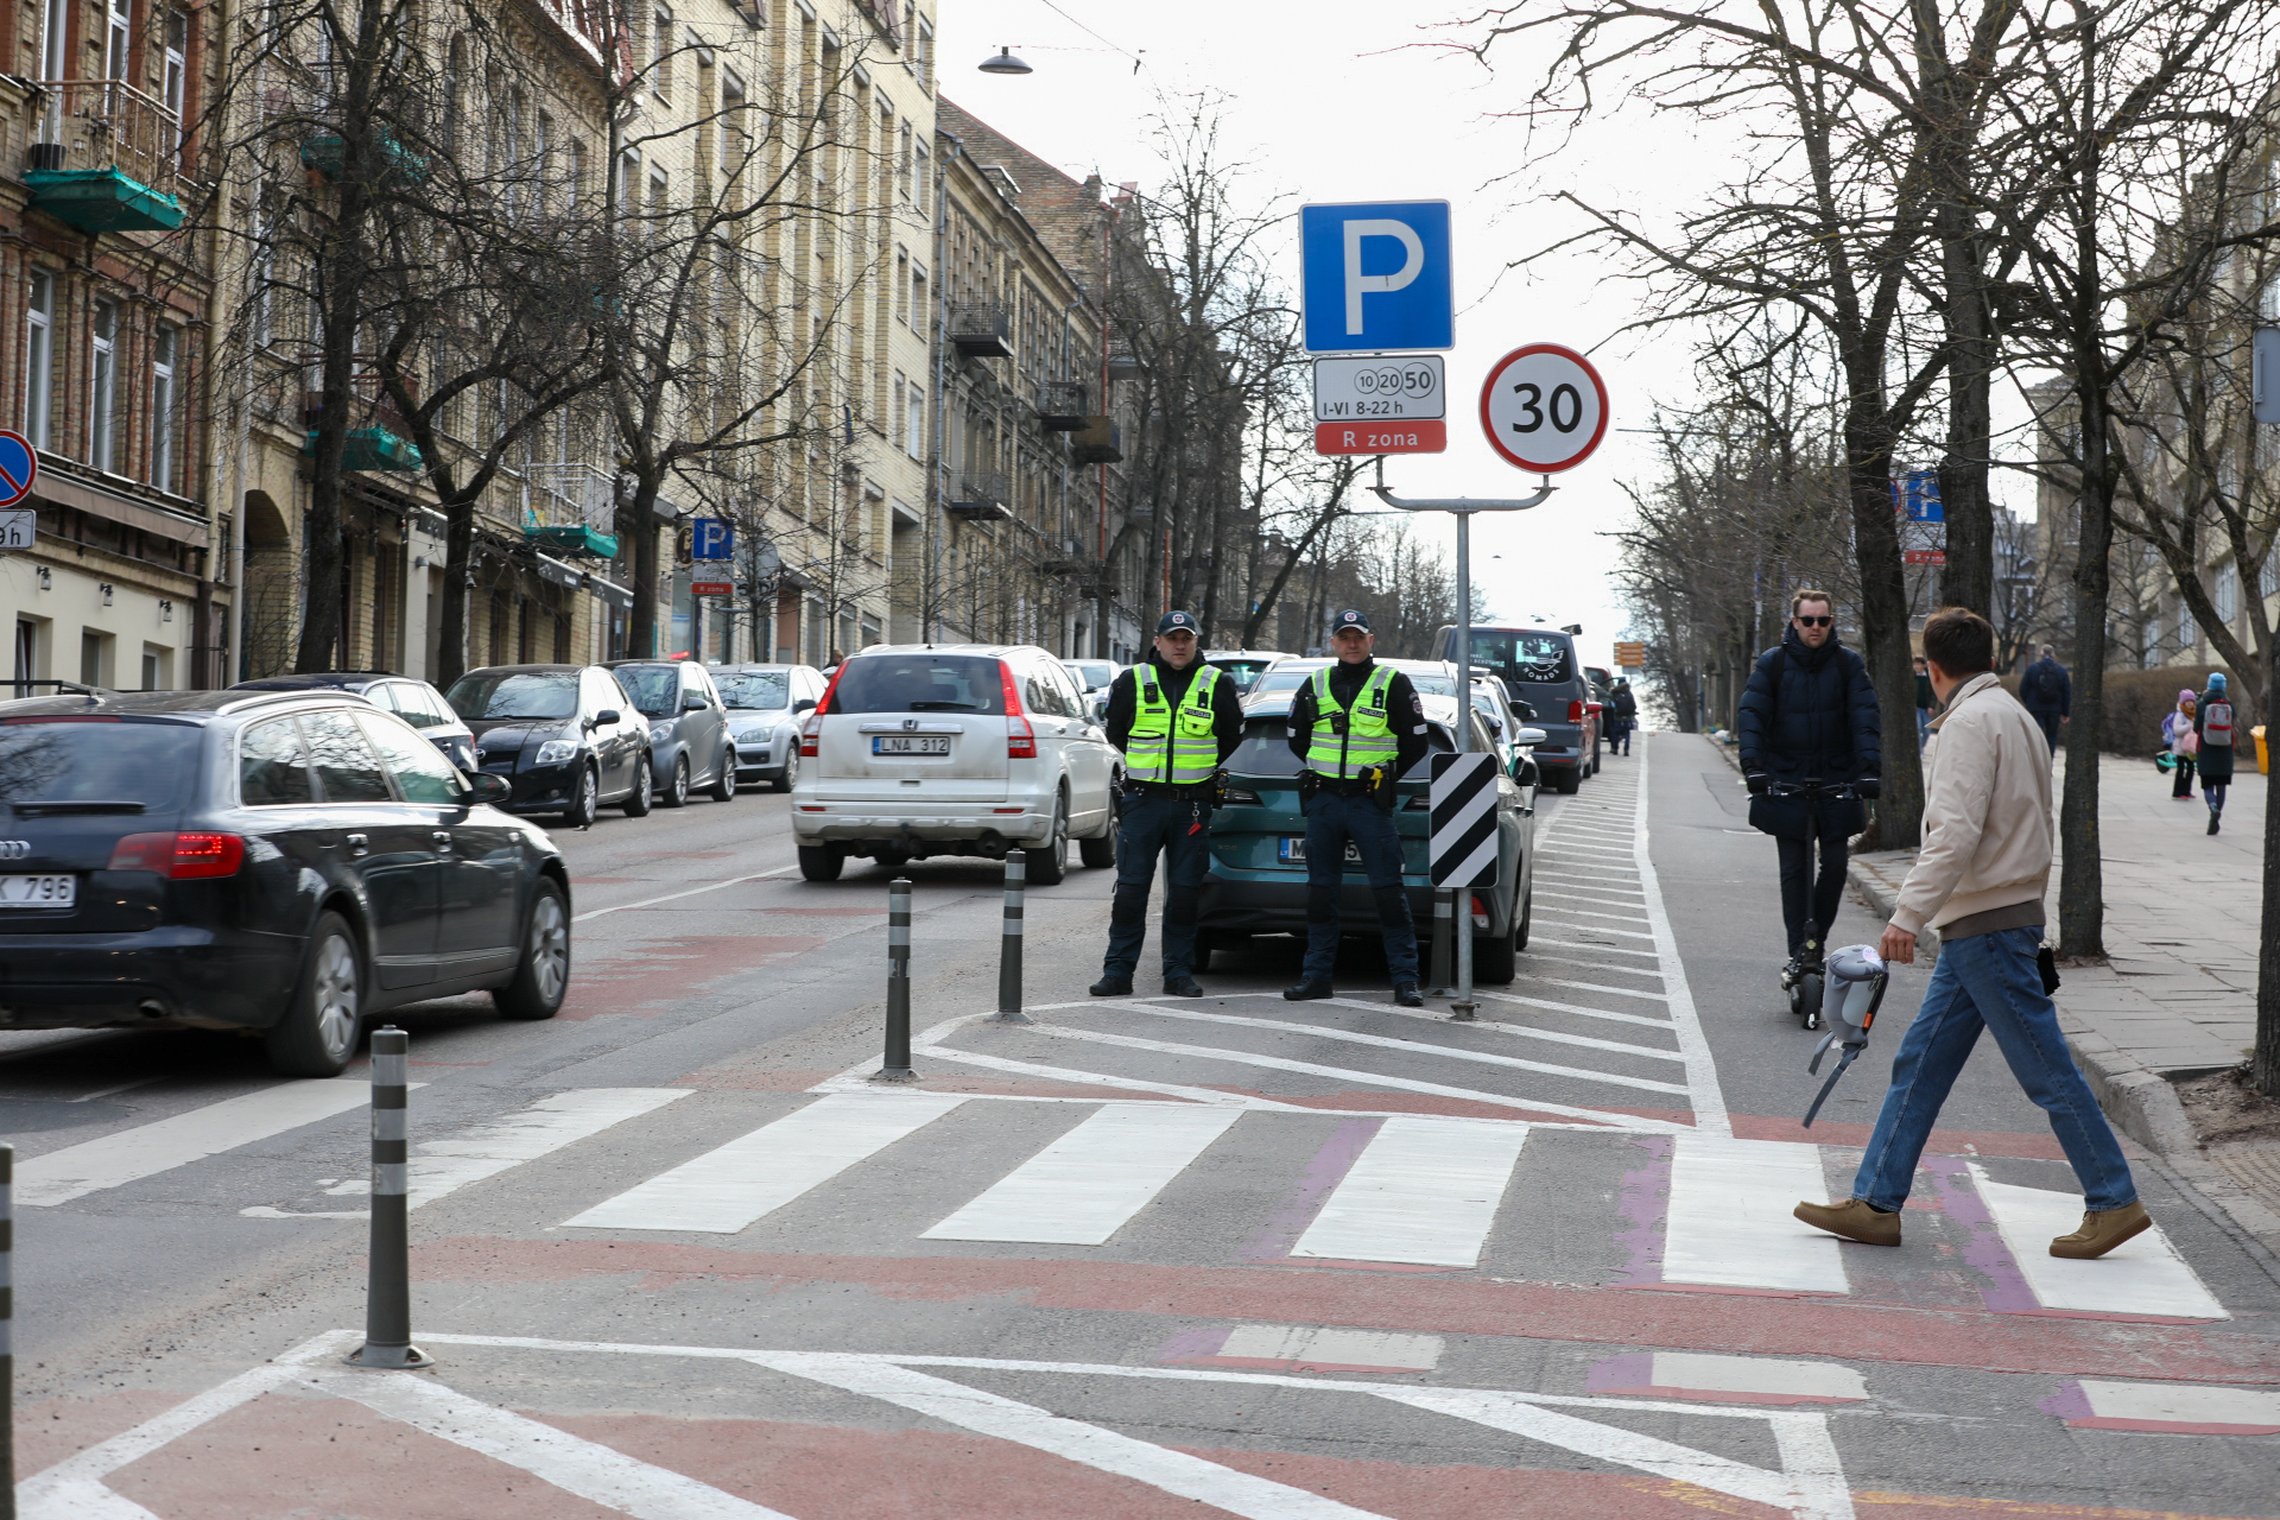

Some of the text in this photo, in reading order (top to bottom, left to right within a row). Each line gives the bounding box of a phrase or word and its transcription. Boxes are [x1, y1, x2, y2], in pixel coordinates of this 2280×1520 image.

[1343, 219, 1425, 335] P
[1360, 371, 1431, 390] 10 20 50
[1323, 401, 1403, 415] I-VI 8-22 h
[1512, 383, 1583, 433] 30
[1343, 431, 1418, 447] R zona
[10, 527, 20, 545] h
[703, 522, 727, 555] P
[1523, 666, 1560, 680] NOMADS
[882, 739, 947, 751] LNA 312
[24, 877, 71, 900] 796
